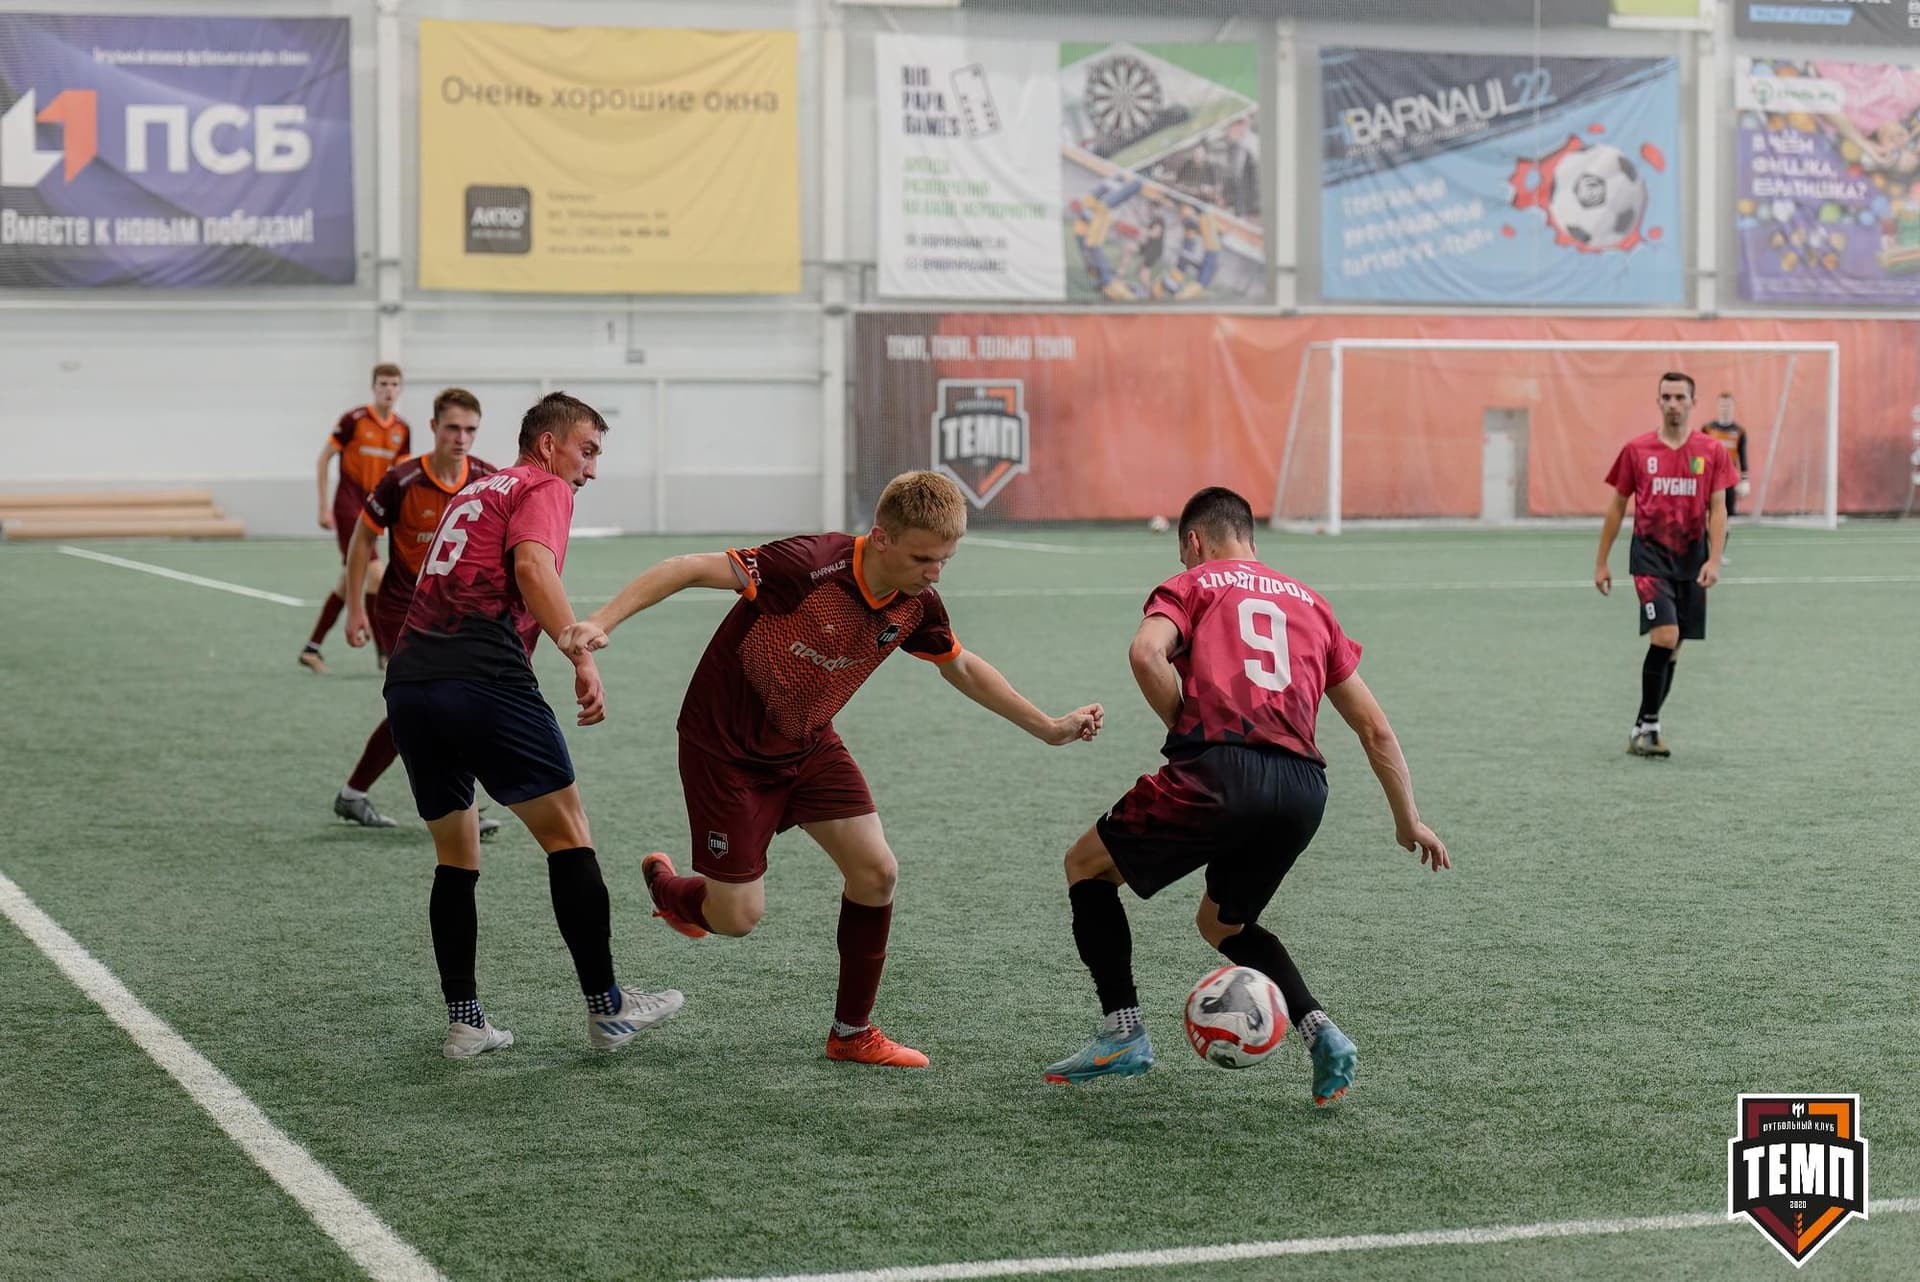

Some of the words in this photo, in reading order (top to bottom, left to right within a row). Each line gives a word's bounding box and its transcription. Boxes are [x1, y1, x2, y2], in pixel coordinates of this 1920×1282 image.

[441, 75, 543, 109] Очень
[550, 84, 696, 116] хорошие
[703, 91, 781, 114] окна
[126, 104, 312, 175] ПСБ
[2, 209, 90, 246] Вместе
[95, 217, 112, 245] к
[115, 217, 199, 246] новым
[203, 209, 314, 248] победам!
[941, 415, 1020, 460] ТЕМП
[1647, 456, 1659, 475] 8
[1652, 476, 1697, 497] РУБИН
[426, 499, 484, 577] 6
[1237, 597, 1292, 693] 9
